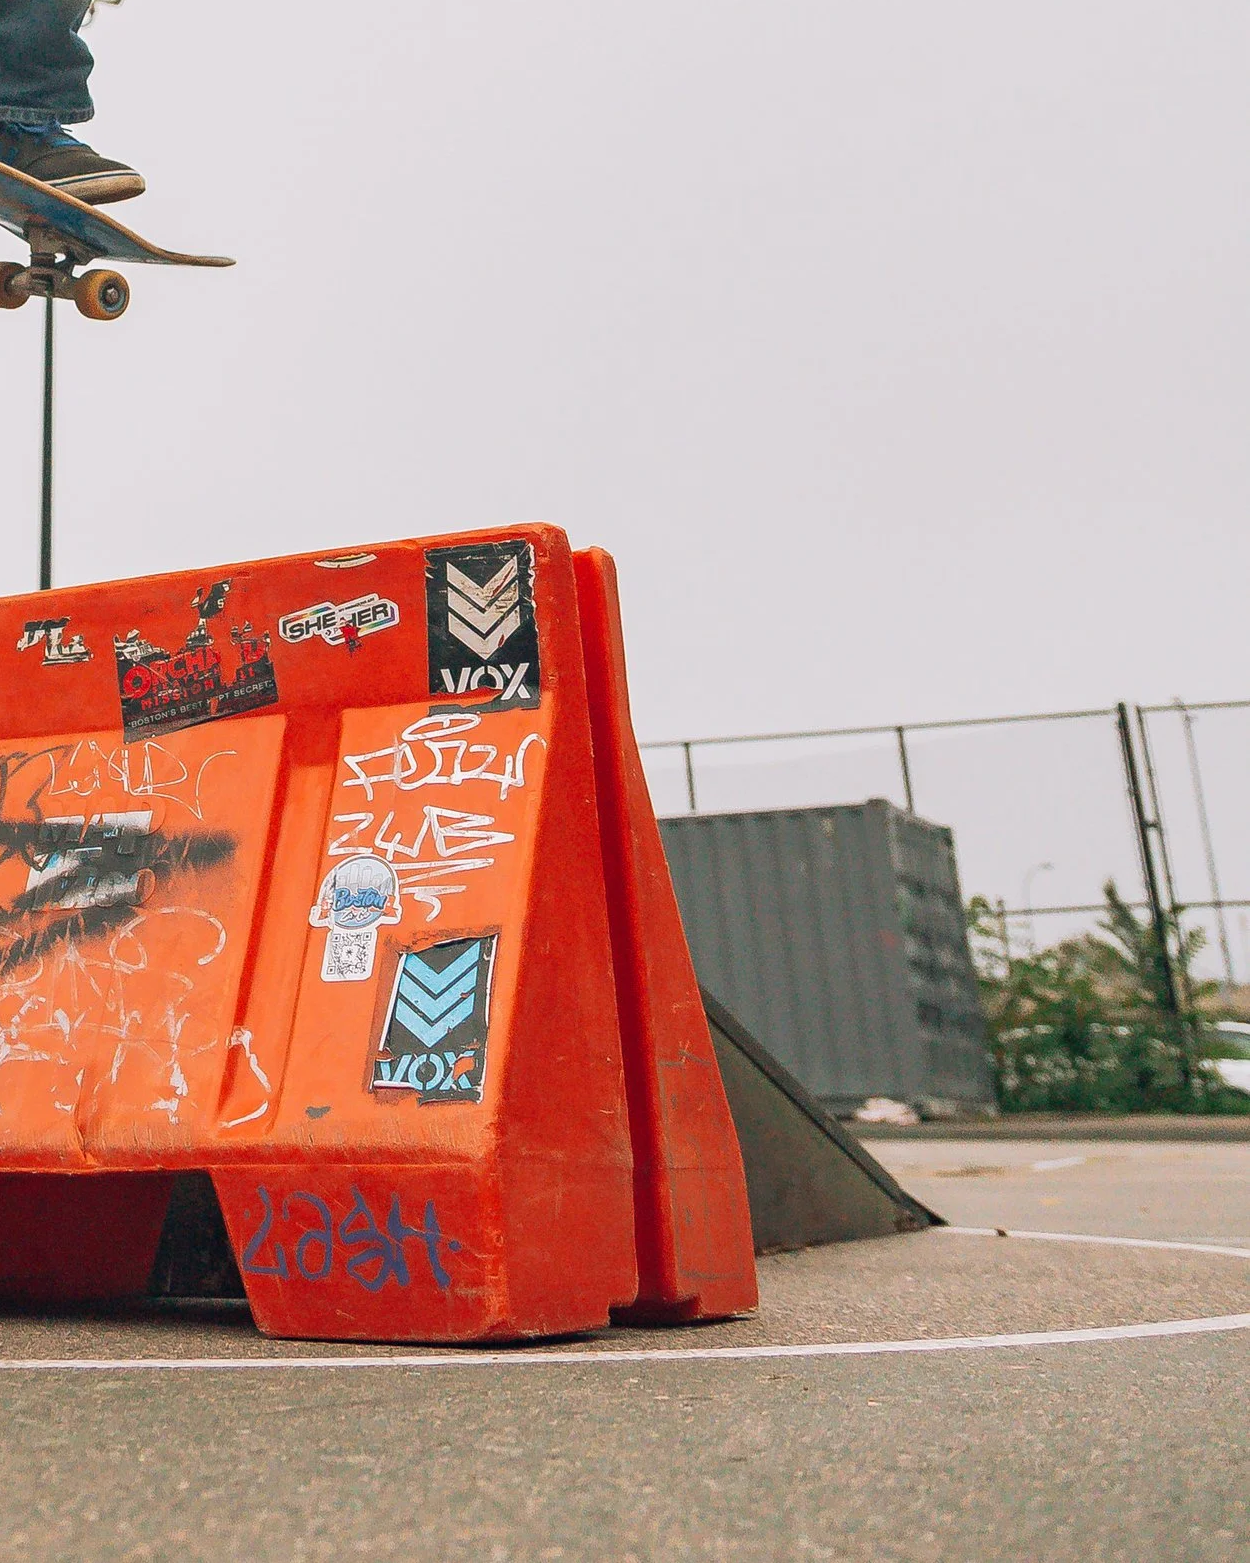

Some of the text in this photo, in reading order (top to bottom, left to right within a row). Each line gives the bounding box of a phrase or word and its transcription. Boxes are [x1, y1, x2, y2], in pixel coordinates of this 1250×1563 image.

[123, 641, 266, 699] ORCHAD
[440, 662, 531, 701] VOX
[379, 1051, 476, 1091] VOX
